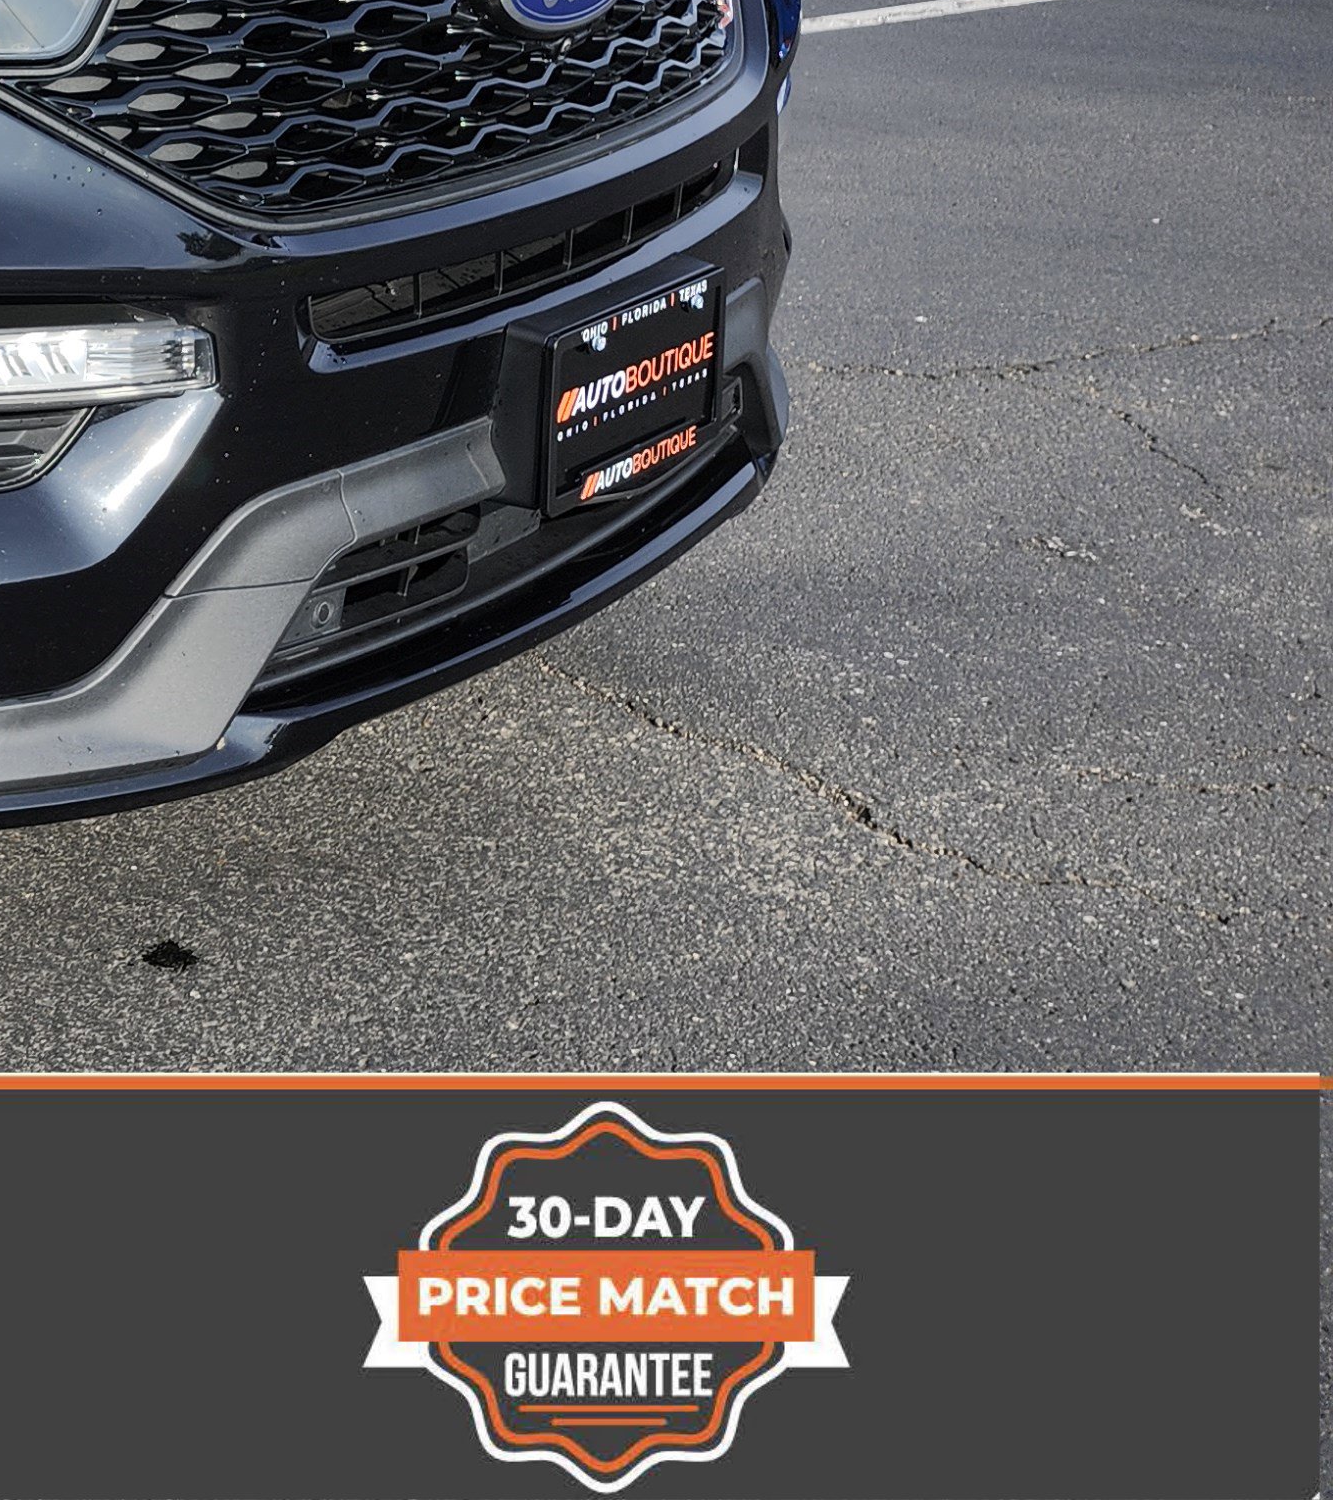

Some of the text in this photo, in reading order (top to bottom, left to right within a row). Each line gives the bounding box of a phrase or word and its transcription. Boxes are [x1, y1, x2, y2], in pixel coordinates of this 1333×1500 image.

[581, 279, 708, 343] OHIO FLORIDA TEXAS
[570, 331, 716, 417] AUTOBOUTIQUE
[557, 420, 589, 442] OHIO
[602, 392, 657, 423] FLORIDA
